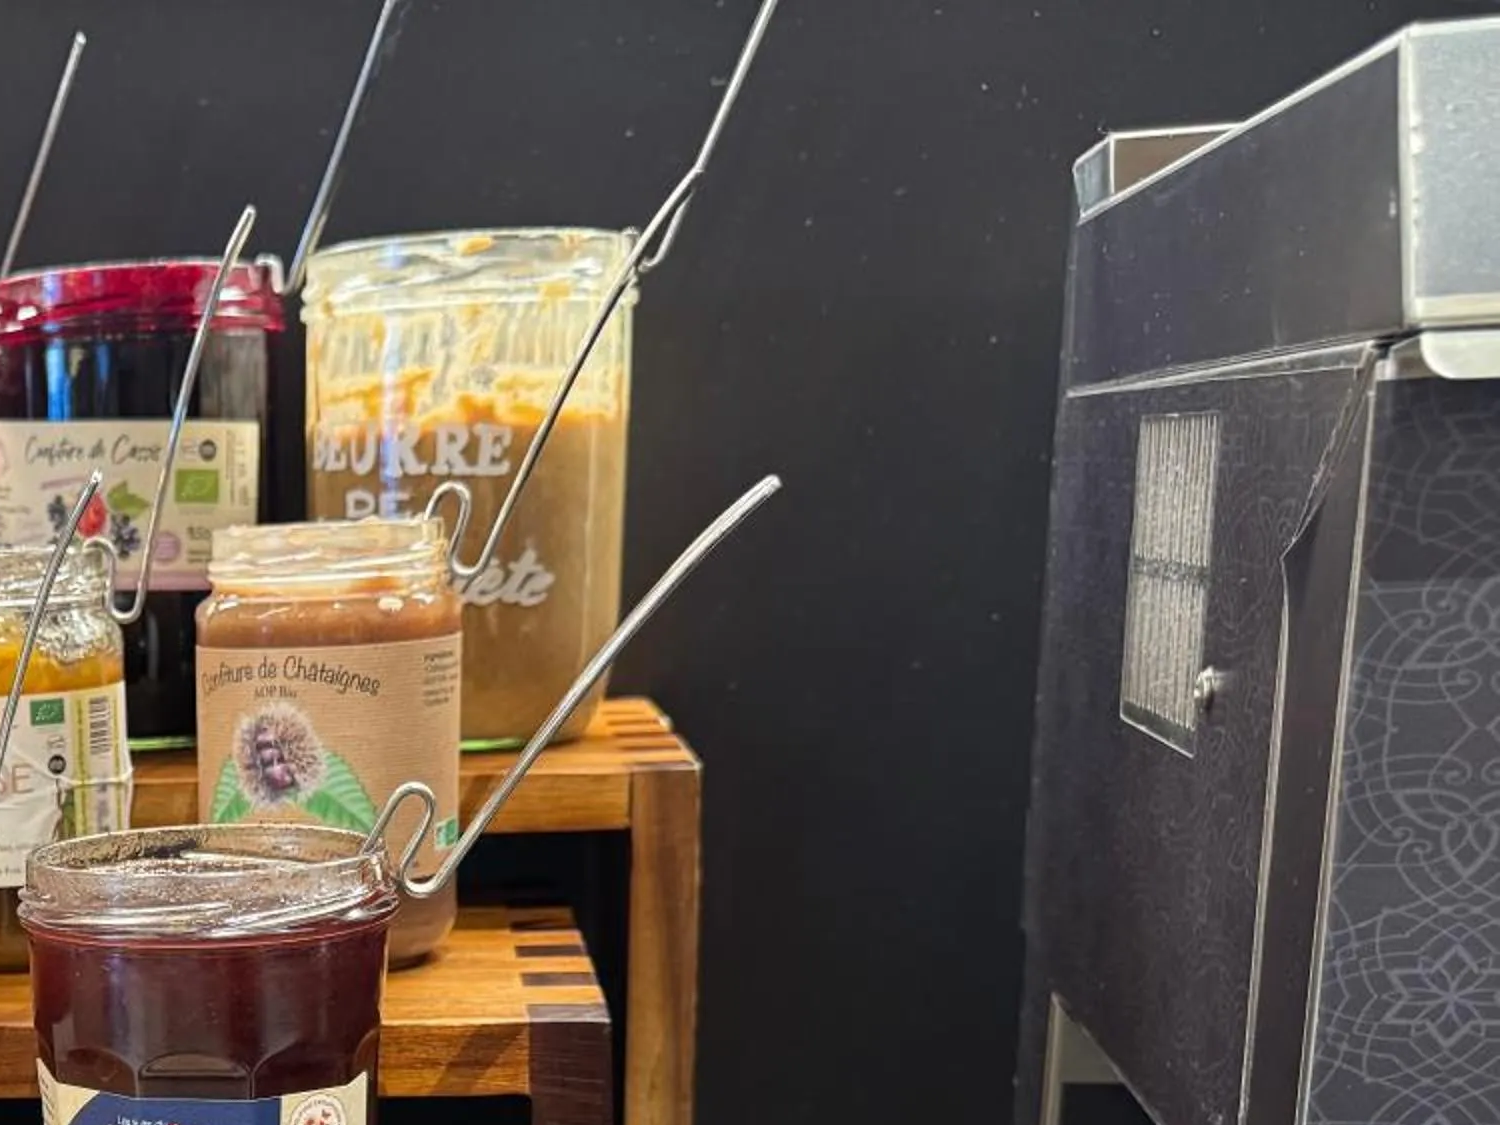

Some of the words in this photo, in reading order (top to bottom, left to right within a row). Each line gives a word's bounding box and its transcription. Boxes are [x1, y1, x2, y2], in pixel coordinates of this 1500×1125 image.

[313, 422, 512, 477] BEURRE
[258, 656, 276, 680] de
[283, 655, 381, 696] Châtaignes
